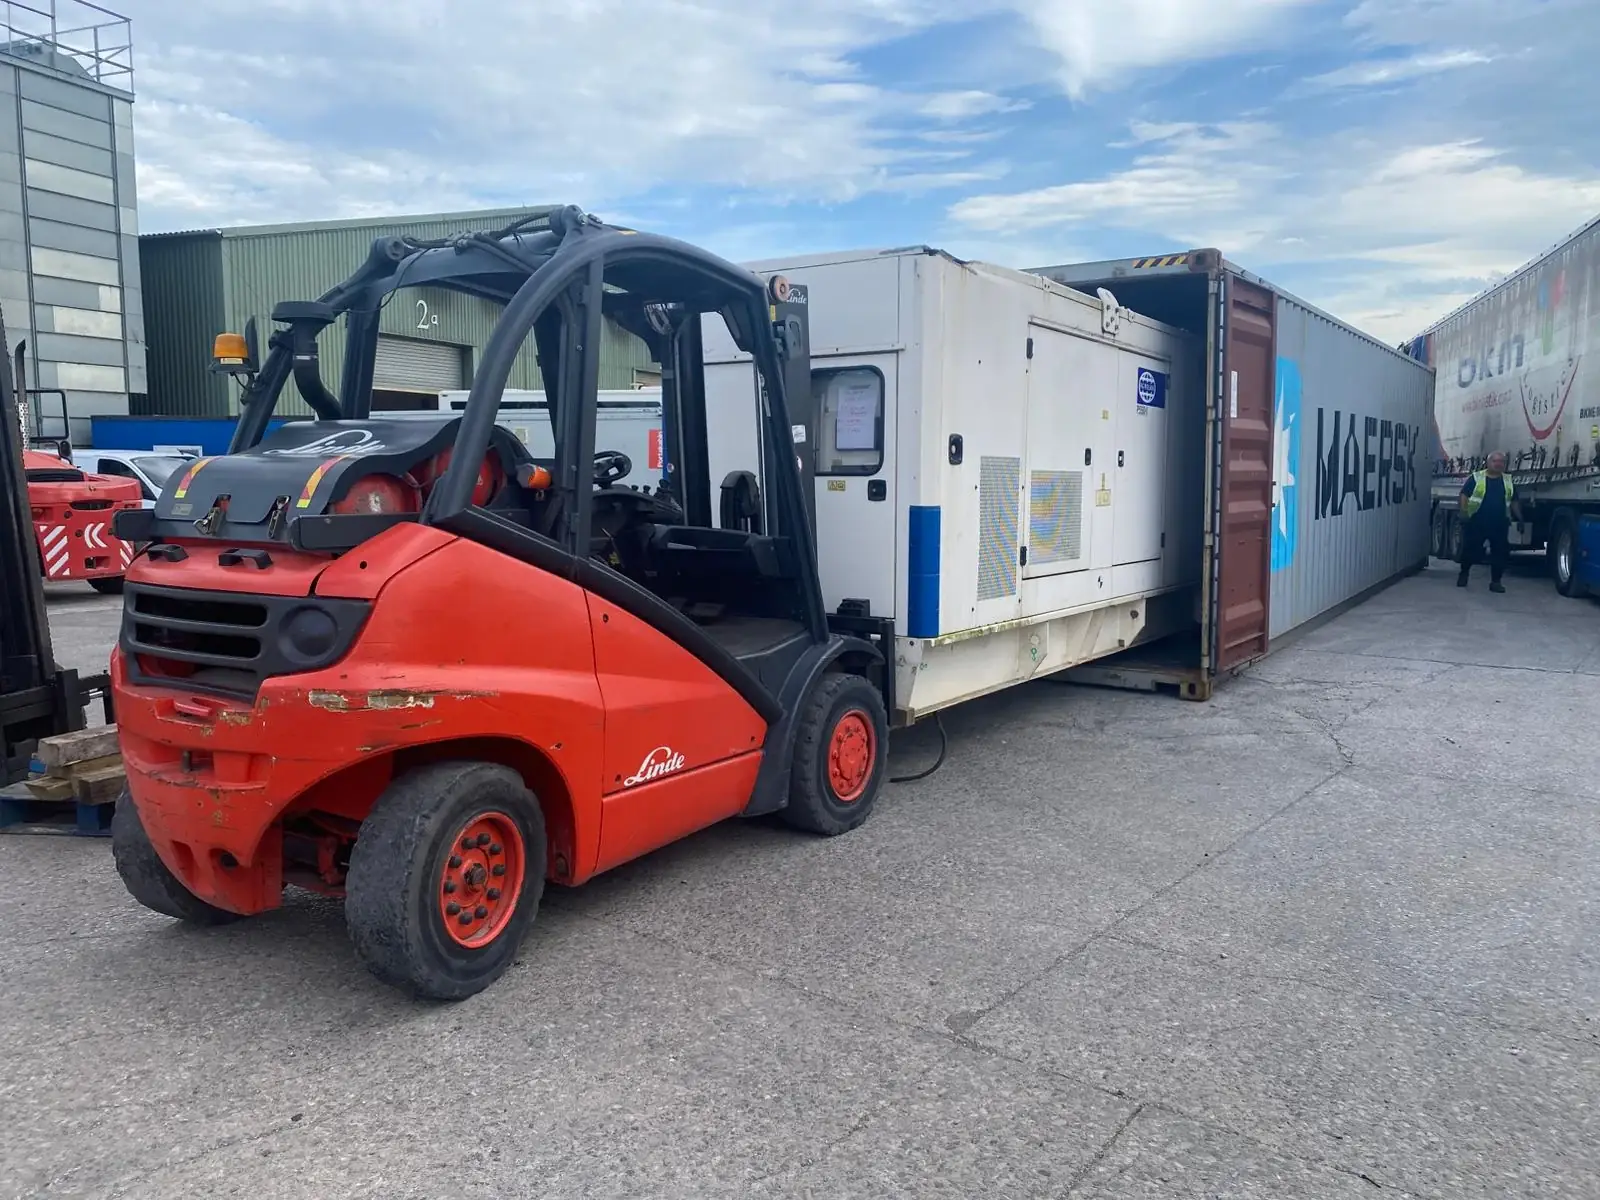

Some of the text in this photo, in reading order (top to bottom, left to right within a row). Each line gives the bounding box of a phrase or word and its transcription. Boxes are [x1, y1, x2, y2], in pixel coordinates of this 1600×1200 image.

[262, 429, 386, 454] Linde
[1315, 407, 1419, 520] MAERSK
[623, 746, 685, 787] Linde
